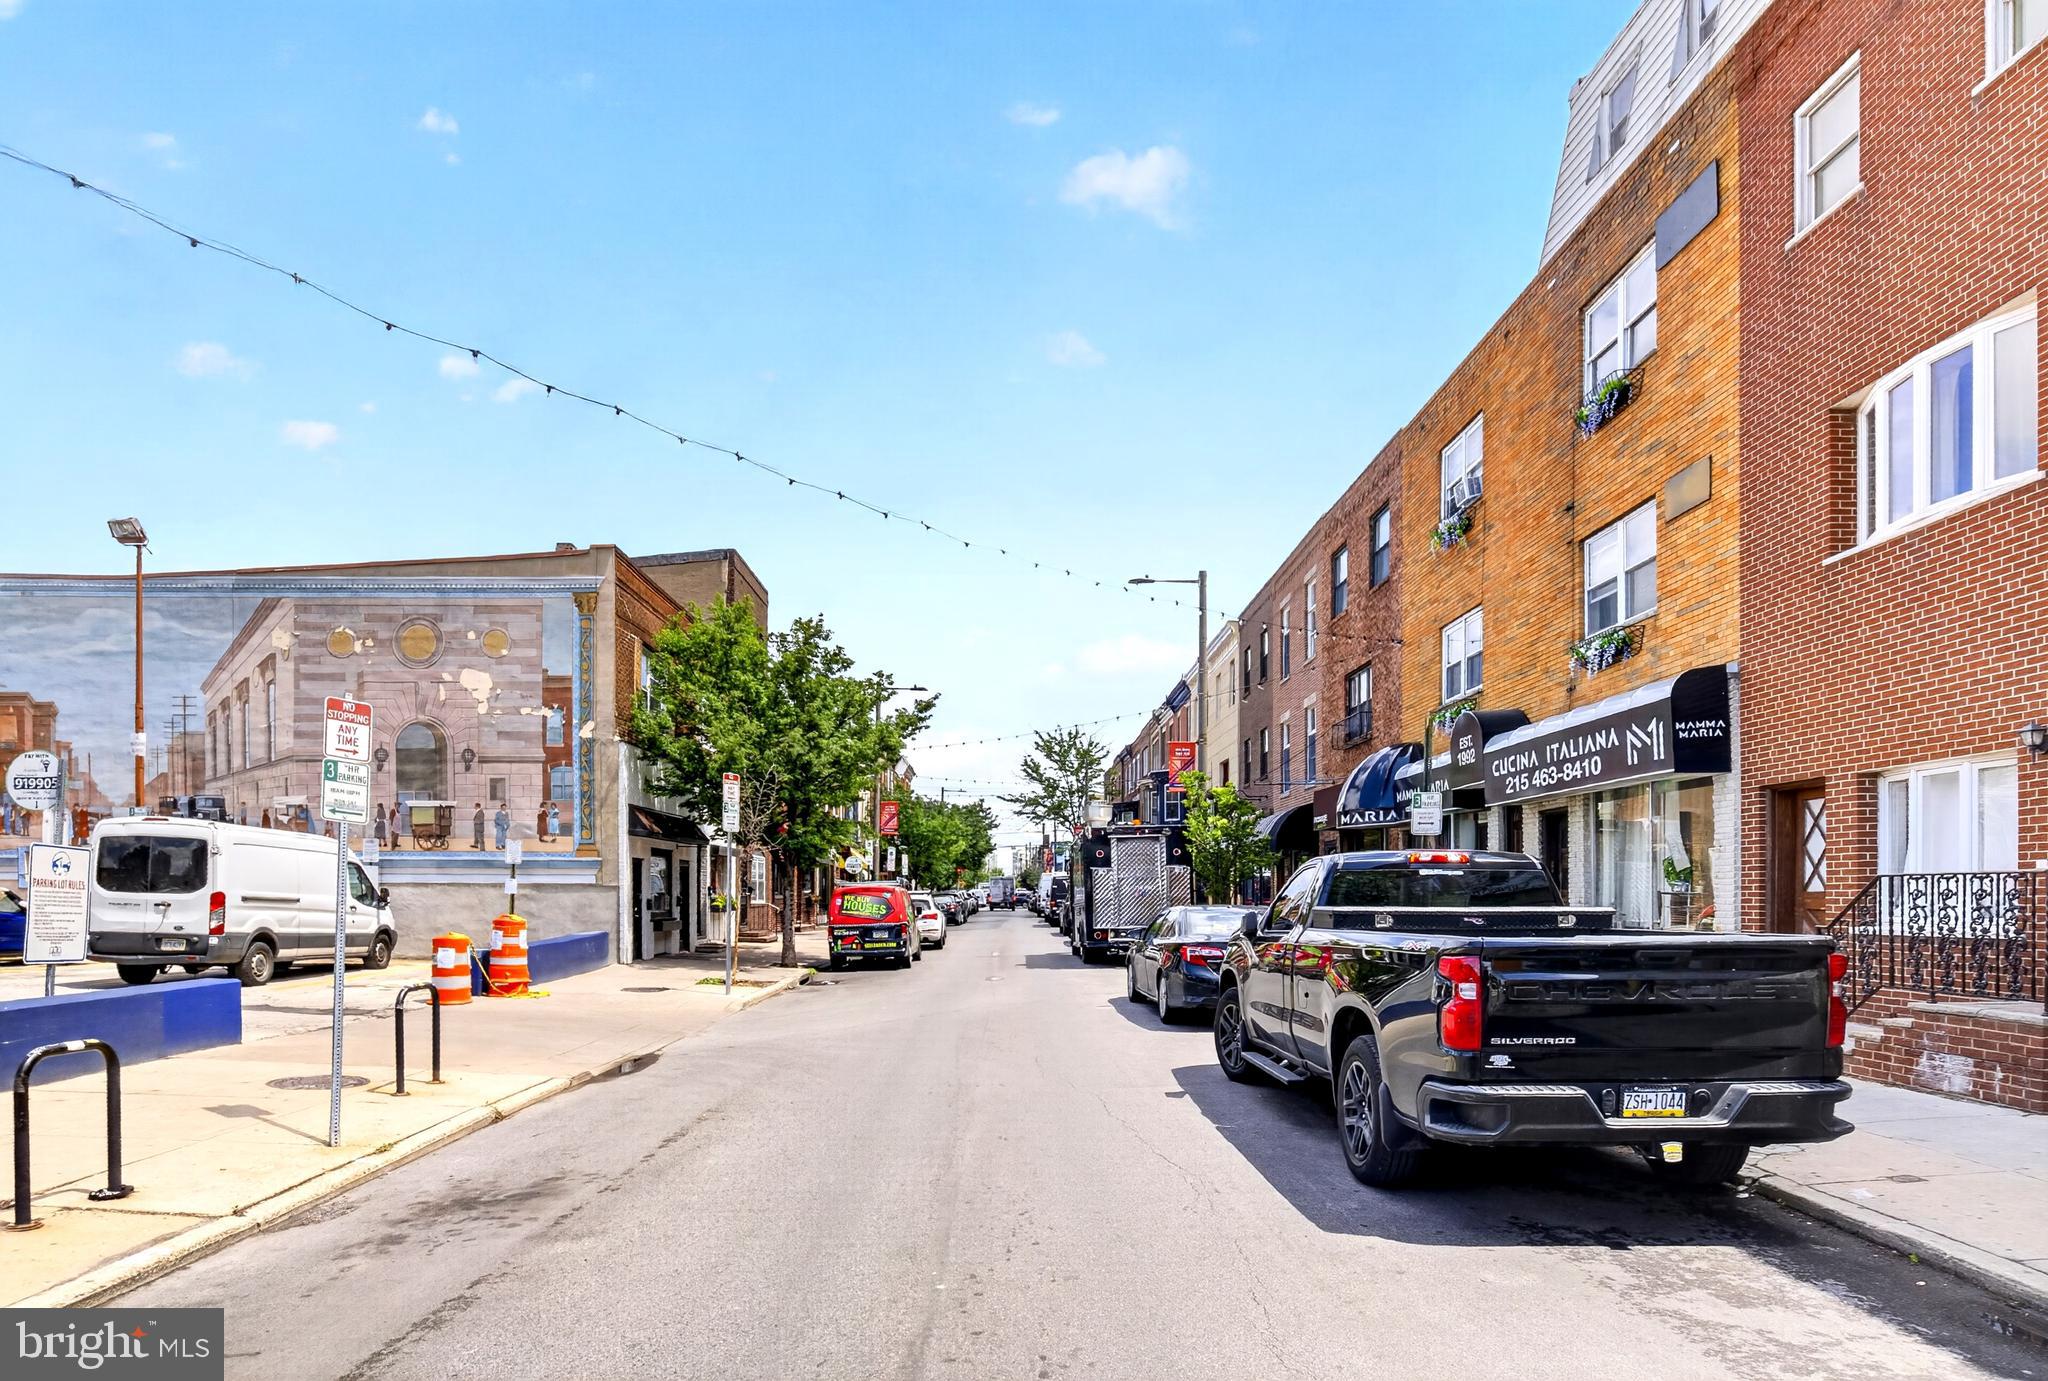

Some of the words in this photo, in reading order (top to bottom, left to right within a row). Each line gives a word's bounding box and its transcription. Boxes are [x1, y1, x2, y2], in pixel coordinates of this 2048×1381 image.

[342, 702, 356, 712] NO
[327, 709, 370, 725] STOPPING
[337, 724, 358, 737] ANY
[1675, 719, 1726, 730] MAMMA
[336, 734, 359, 747] TIME
[1678, 728, 1723, 739] MARIA
[1459, 734, 1473, 750] EST.
[1456, 748, 1476, 767] 1992
[1491, 748, 1539, 778] CUCINA
[1545, 727, 1620, 760] ITALIANA
[326, 762, 335, 778] 3
[1505, 775, 1530, 795] 215
[1531, 755, 1602, 787] 463-8410
[338, 772, 367, 785] PARKING
[1341, 810, 1400, 825] MARIA
[33, 877, 57, 889] PARKING
[57, 879, 68, 890] LOT
[68, 880, 86, 890] RULES
[843, 900, 887, 915] HOUSES
[1490, 1037, 1577, 1045] SILVERADO
